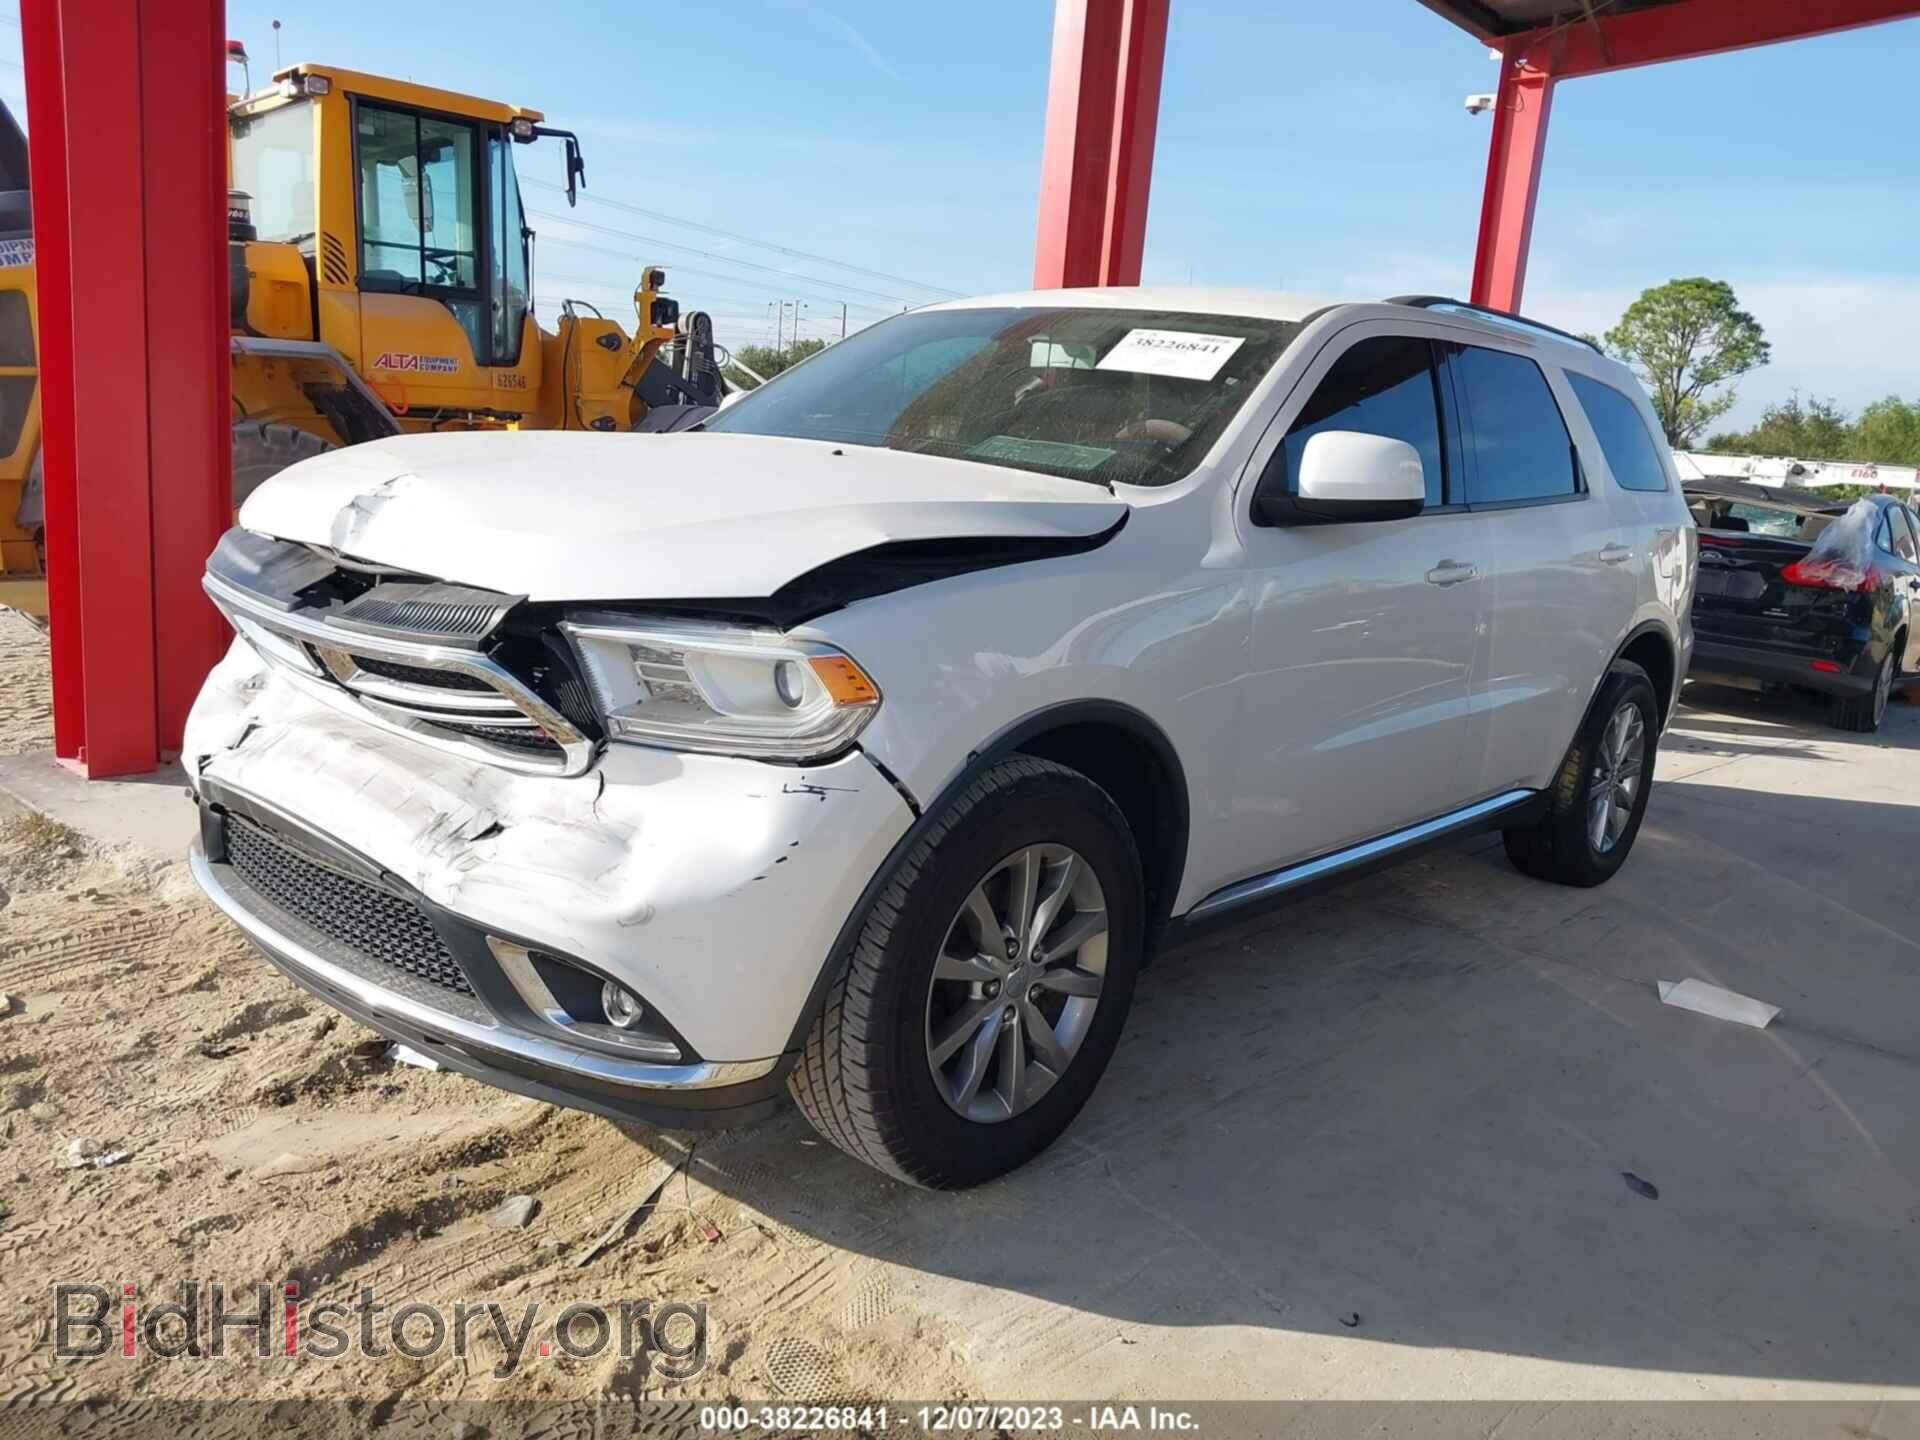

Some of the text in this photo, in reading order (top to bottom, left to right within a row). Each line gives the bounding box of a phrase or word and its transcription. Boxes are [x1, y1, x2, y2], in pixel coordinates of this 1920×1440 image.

[1136, 338, 1220, 353] 38226841
[373, 353, 418, 370] ALTA
[420, 363, 458, 372] COMPANY
